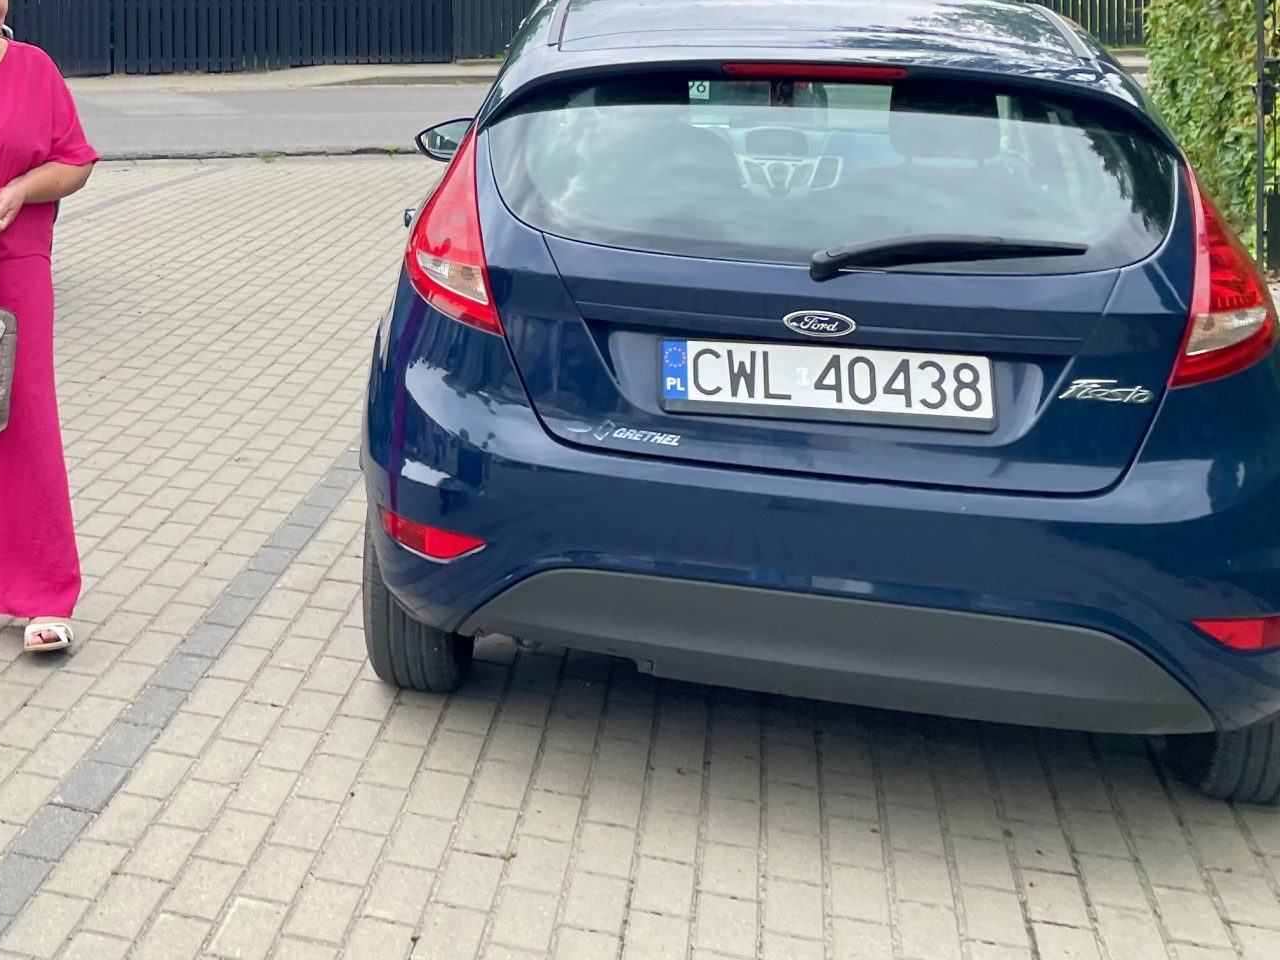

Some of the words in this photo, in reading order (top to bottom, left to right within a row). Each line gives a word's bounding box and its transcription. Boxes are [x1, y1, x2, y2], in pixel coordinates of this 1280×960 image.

[800, 315, 839, 331] Ford
[666, 377, 685, 391] PL
[692, 348, 792, 400] CWL
[813, 354, 982, 412] 40438
[1059, 379, 1153, 403] Fiesta
[612, 427, 681, 446] GRETHEL
